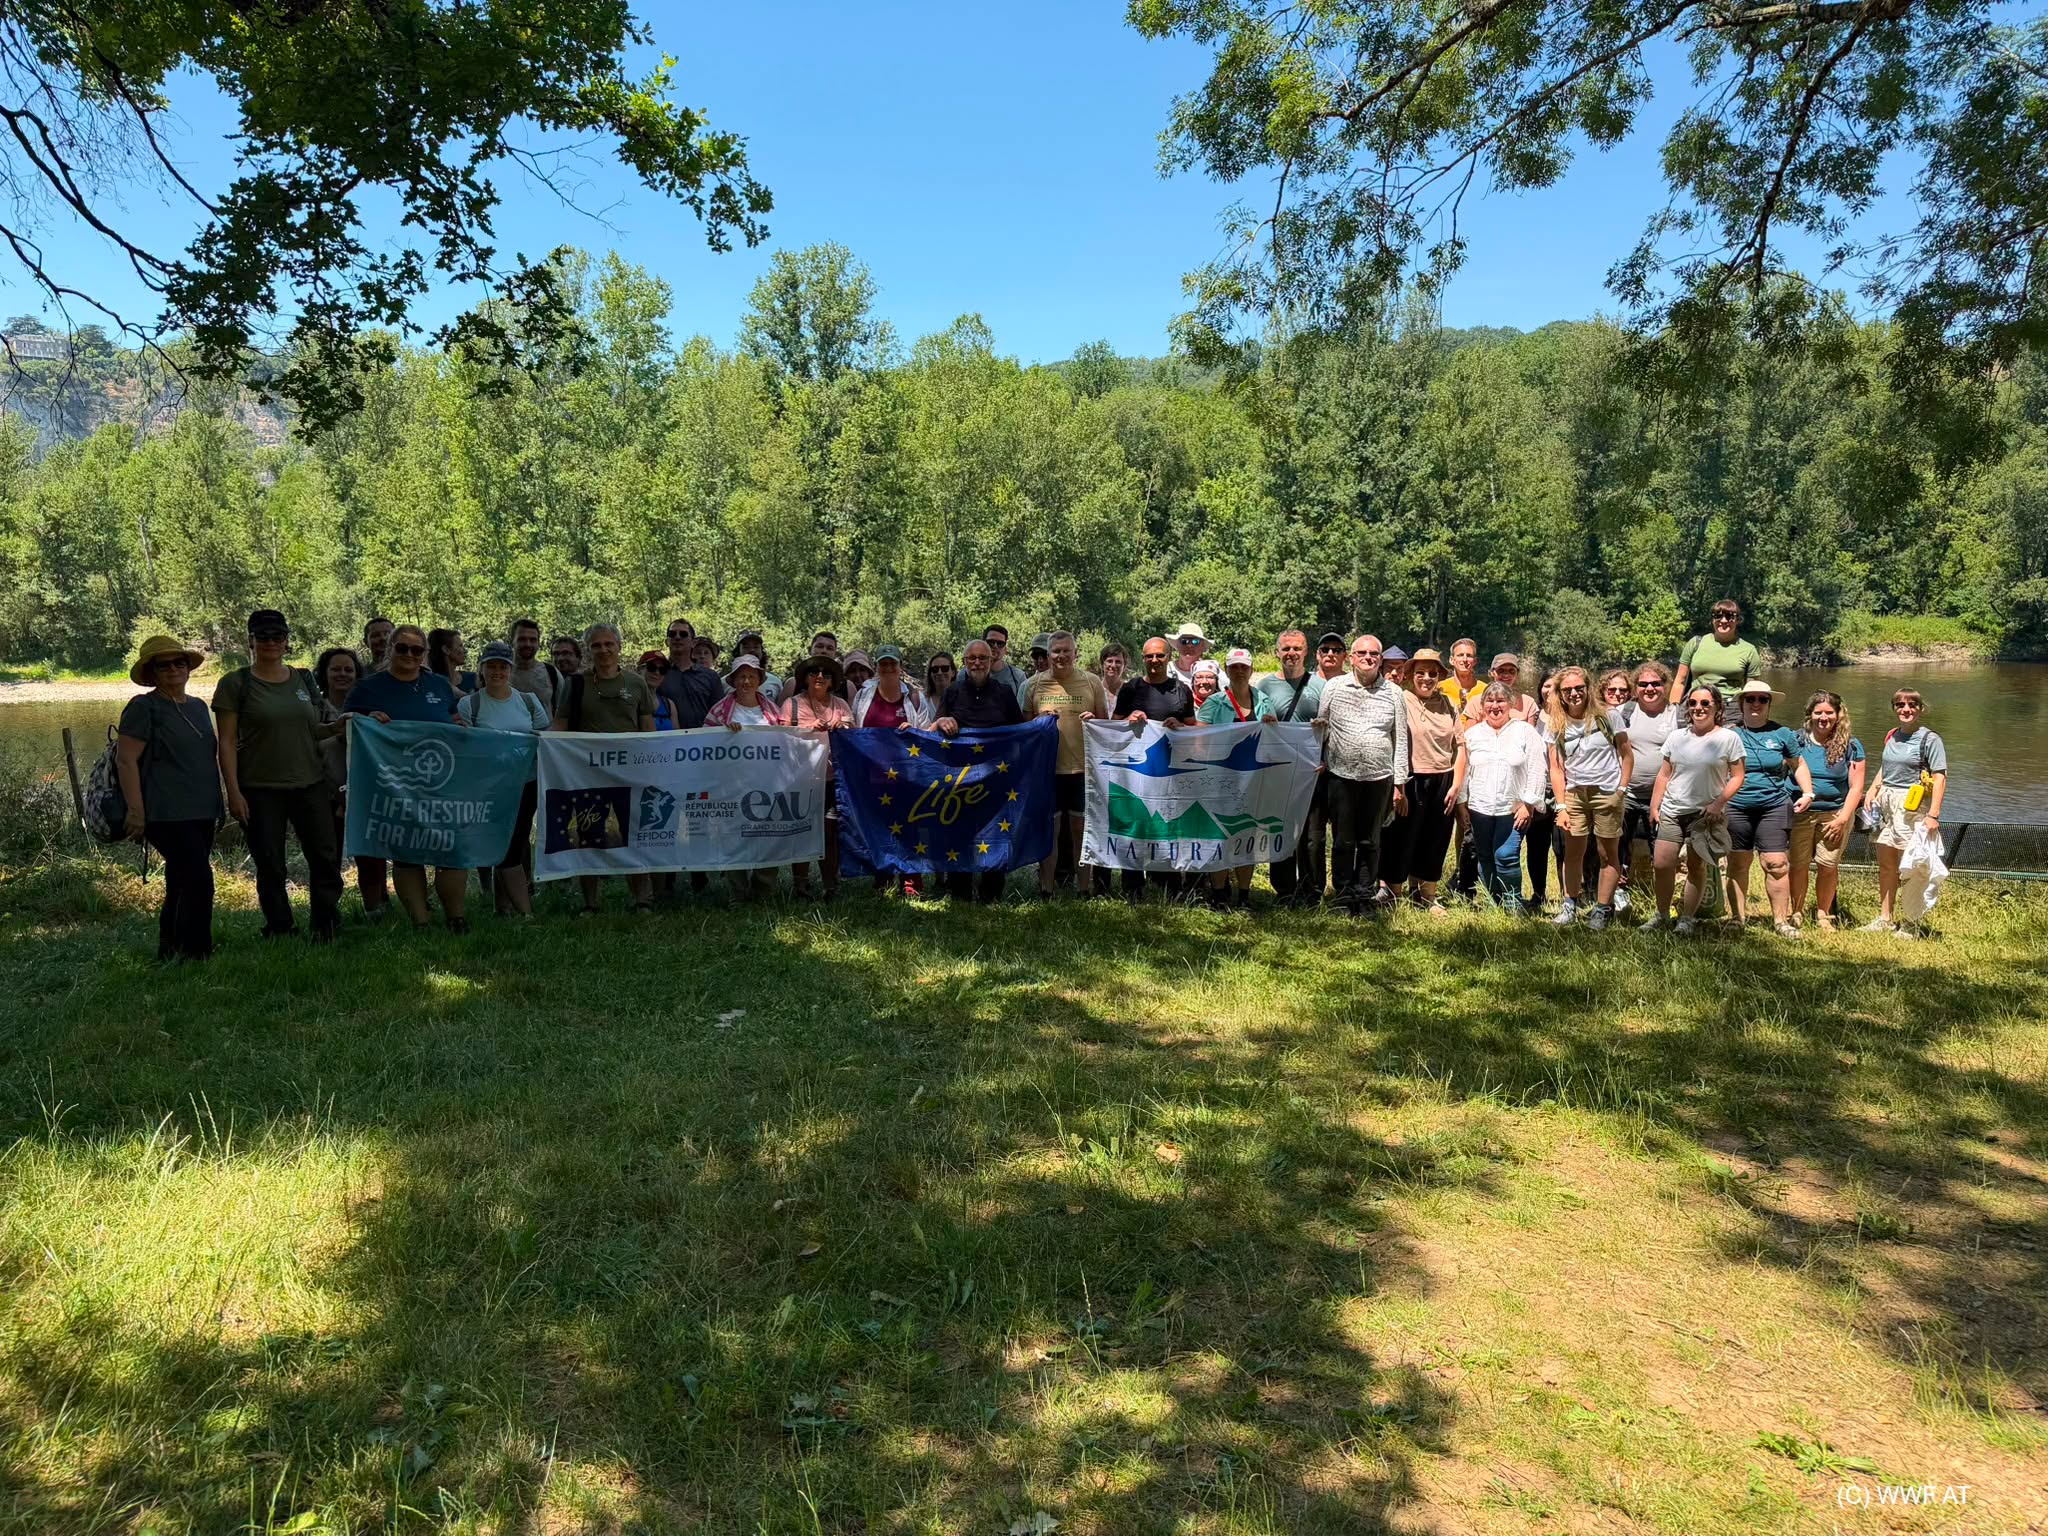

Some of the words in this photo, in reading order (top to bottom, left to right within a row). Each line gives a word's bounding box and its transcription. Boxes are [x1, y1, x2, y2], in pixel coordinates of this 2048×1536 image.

[589, 750, 628, 767] LIFE
[674, 745, 781, 763] DORDOGNE
[370, 793, 413, 821] LIFE
[418, 799, 494, 825] RESTORE
[907, 763, 990, 825] Life
[364, 818, 405, 848] FOR
[409, 828, 456, 852] MDD
[1106, 836, 1223, 861] NATURA
[1234, 834, 1283, 856] 2000
